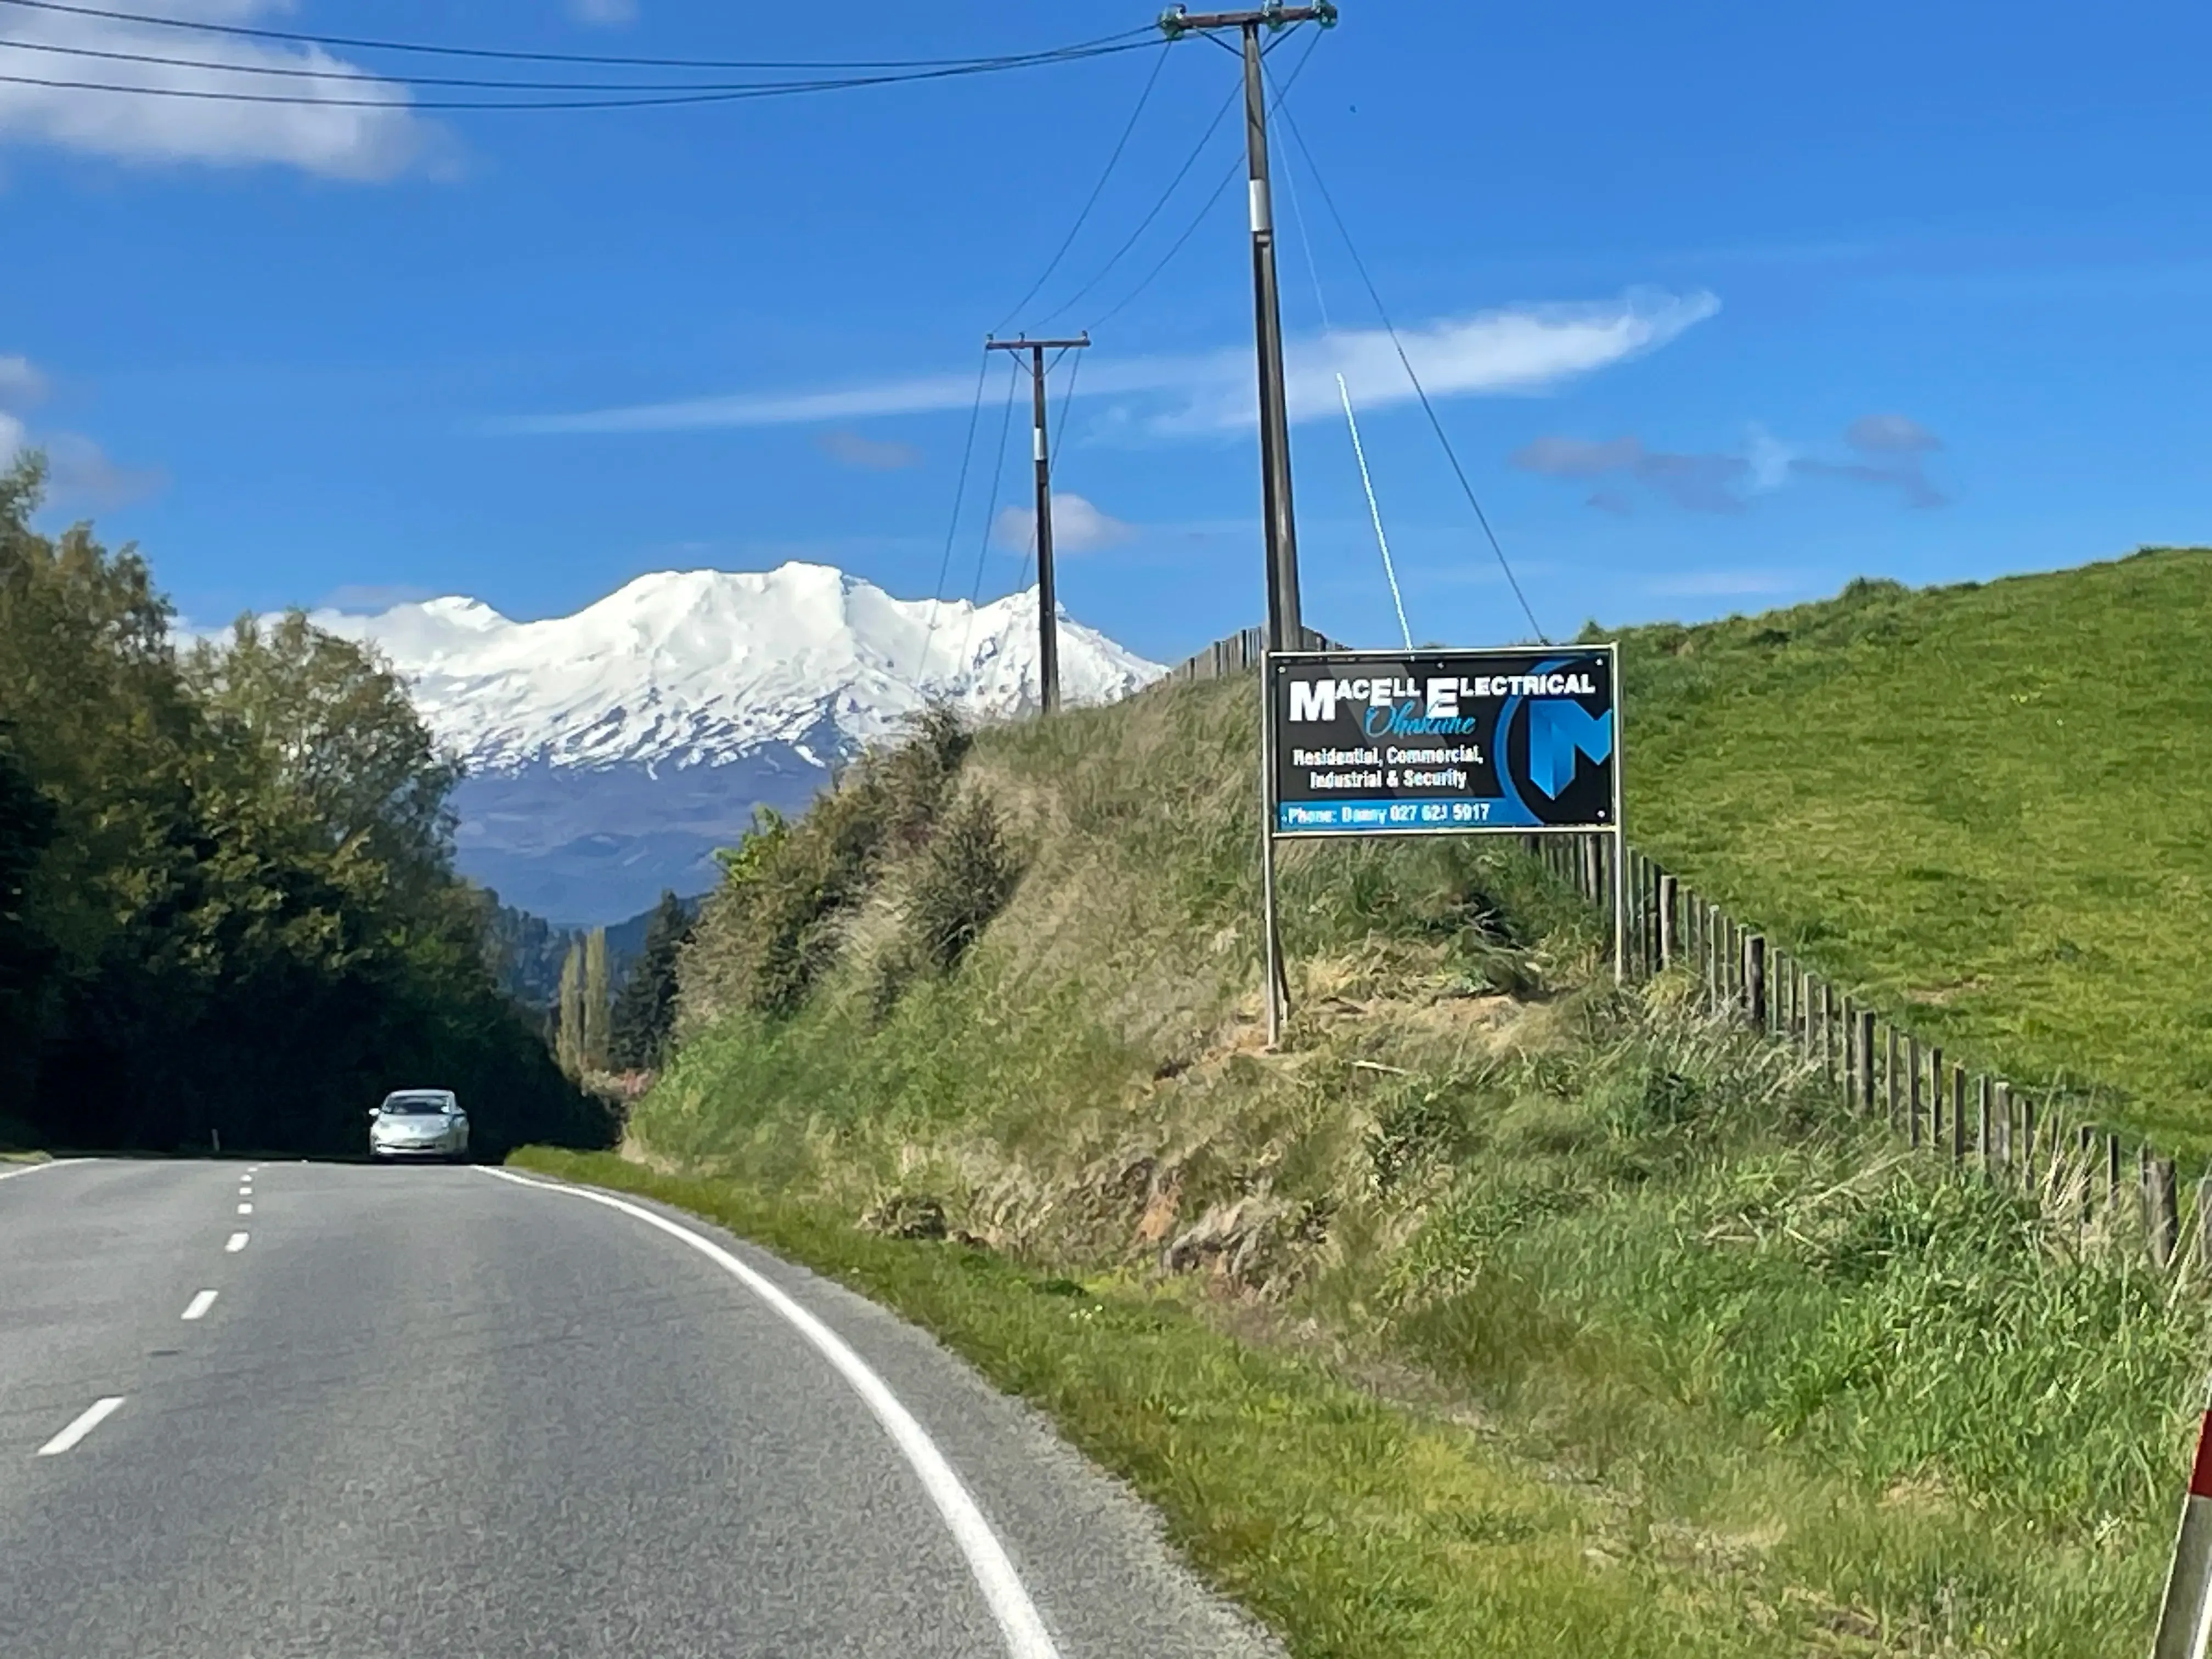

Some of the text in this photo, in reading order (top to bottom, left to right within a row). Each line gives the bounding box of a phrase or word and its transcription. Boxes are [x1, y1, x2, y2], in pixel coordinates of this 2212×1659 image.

[1427, 674, 1595, 718] ELECTRICAL
[1293, 746, 1483, 766] Residential, Commercial,
[1310, 768, 1466, 789] Industrial & Security
[1390, 804, 1418, 821] 027
